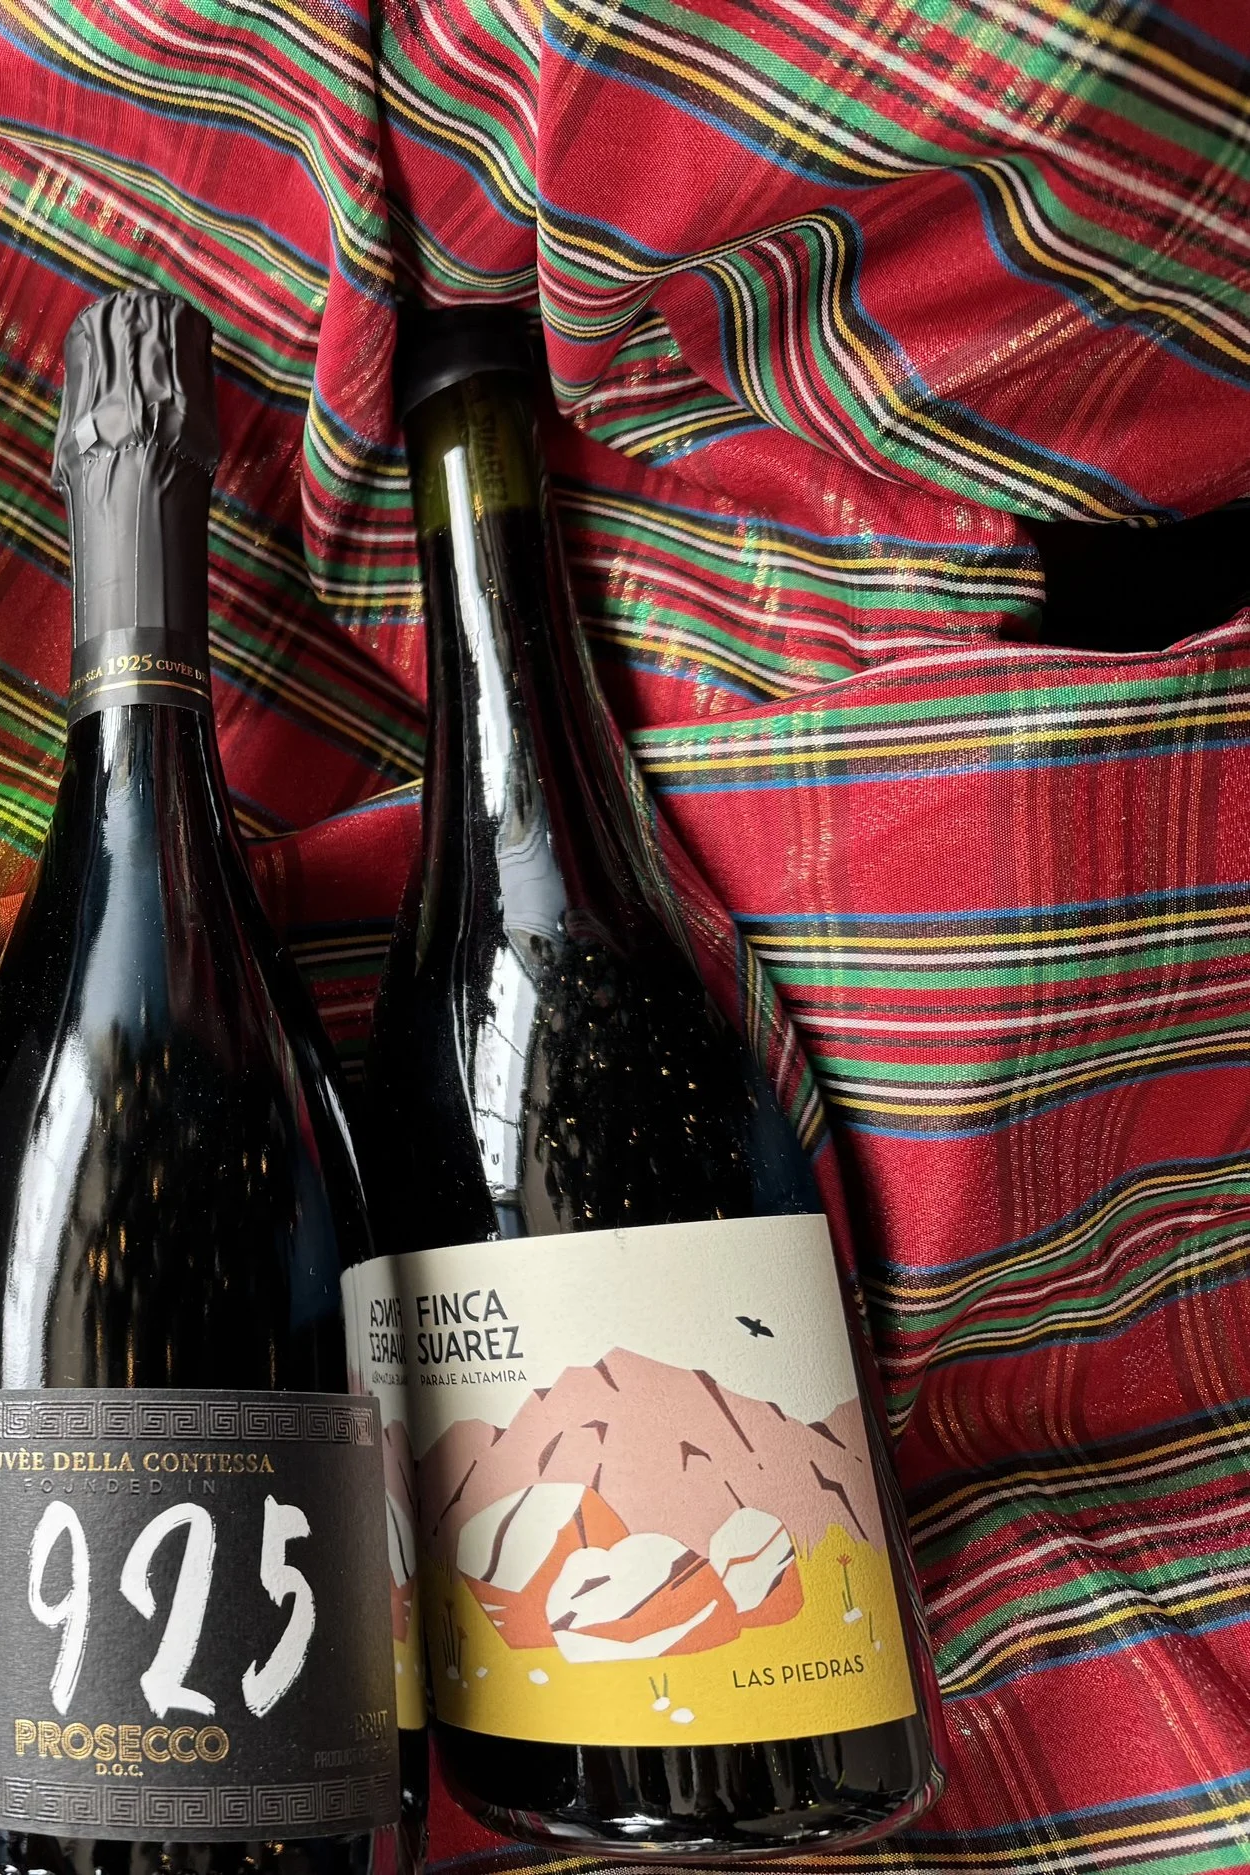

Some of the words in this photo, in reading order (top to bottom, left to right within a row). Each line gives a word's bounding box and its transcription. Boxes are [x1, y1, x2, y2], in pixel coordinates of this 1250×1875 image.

[107, 653, 153, 676] 1925
[416, 1288, 508, 1327] FINCA
[417, 1325, 524, 1365] SUAREZ
[420, 1373, 457, 1387] PARAJE
[461, 1370, 527, 1385] ALTAMIRA
[53, 1452, 134, 1472] DELLA
[142, 1452, 275, 1473] CONTESSA
[23, 1478, 164, 1495] FOUNDED
[187, 1478, 216, 1495] IN
[733, 1667, 775, 1688] LAS
[782, 1655, 865, 1684] PIEDRAS
[14, 1718, 230, 1763] PROSECCO
[95, 1762, 144, 1777] D.O.C.
